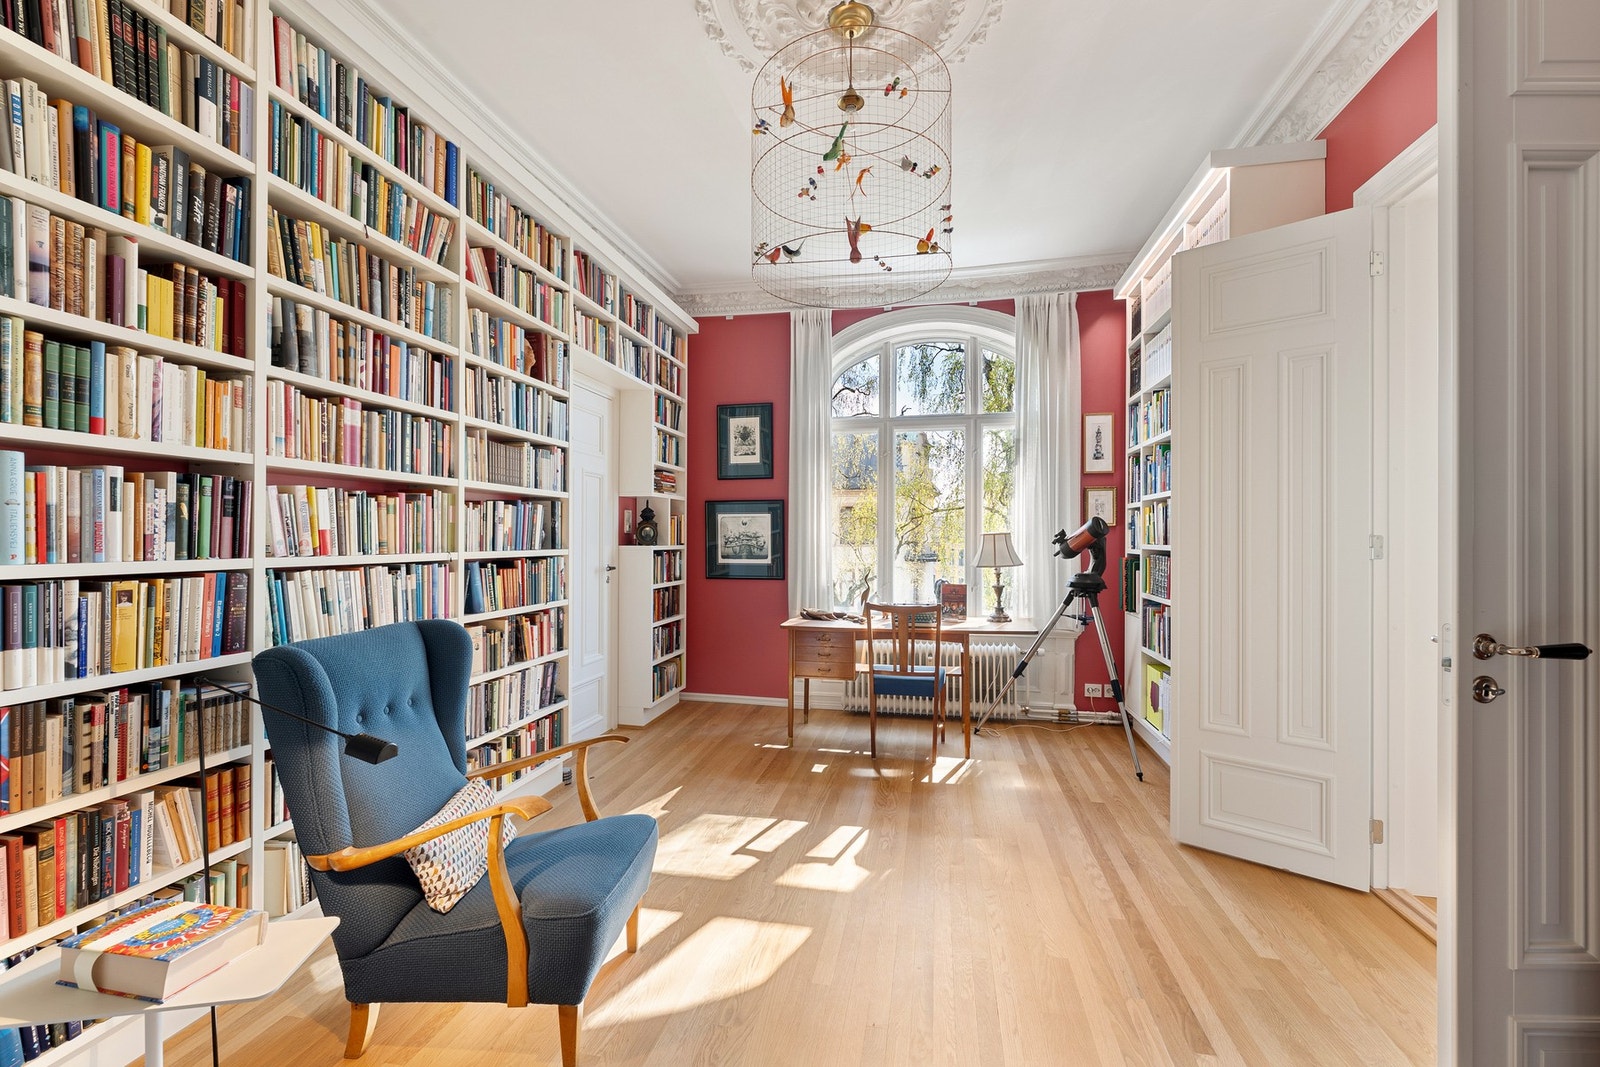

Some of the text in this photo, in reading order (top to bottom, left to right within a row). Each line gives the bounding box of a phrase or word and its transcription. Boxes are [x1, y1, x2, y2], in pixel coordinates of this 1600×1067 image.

[12, 95, 22, 125] FORD
[158, 158, 167, 211] JONATHAN FRANZEN
[9, 457, 18, 496] ANNA GRUE
[9, 508, 18, 549] ITALIENSVEJ
[11, 726, 20, 752] Hemingway
[24, 723, 33, 750] Hemingway
[36, 721, 45, 747] Hemingway
[91, 857, 100, 886] Nibelungen
[104, 856, 113, 890] SLAM
[150, 910, 233, 951] WORLD
